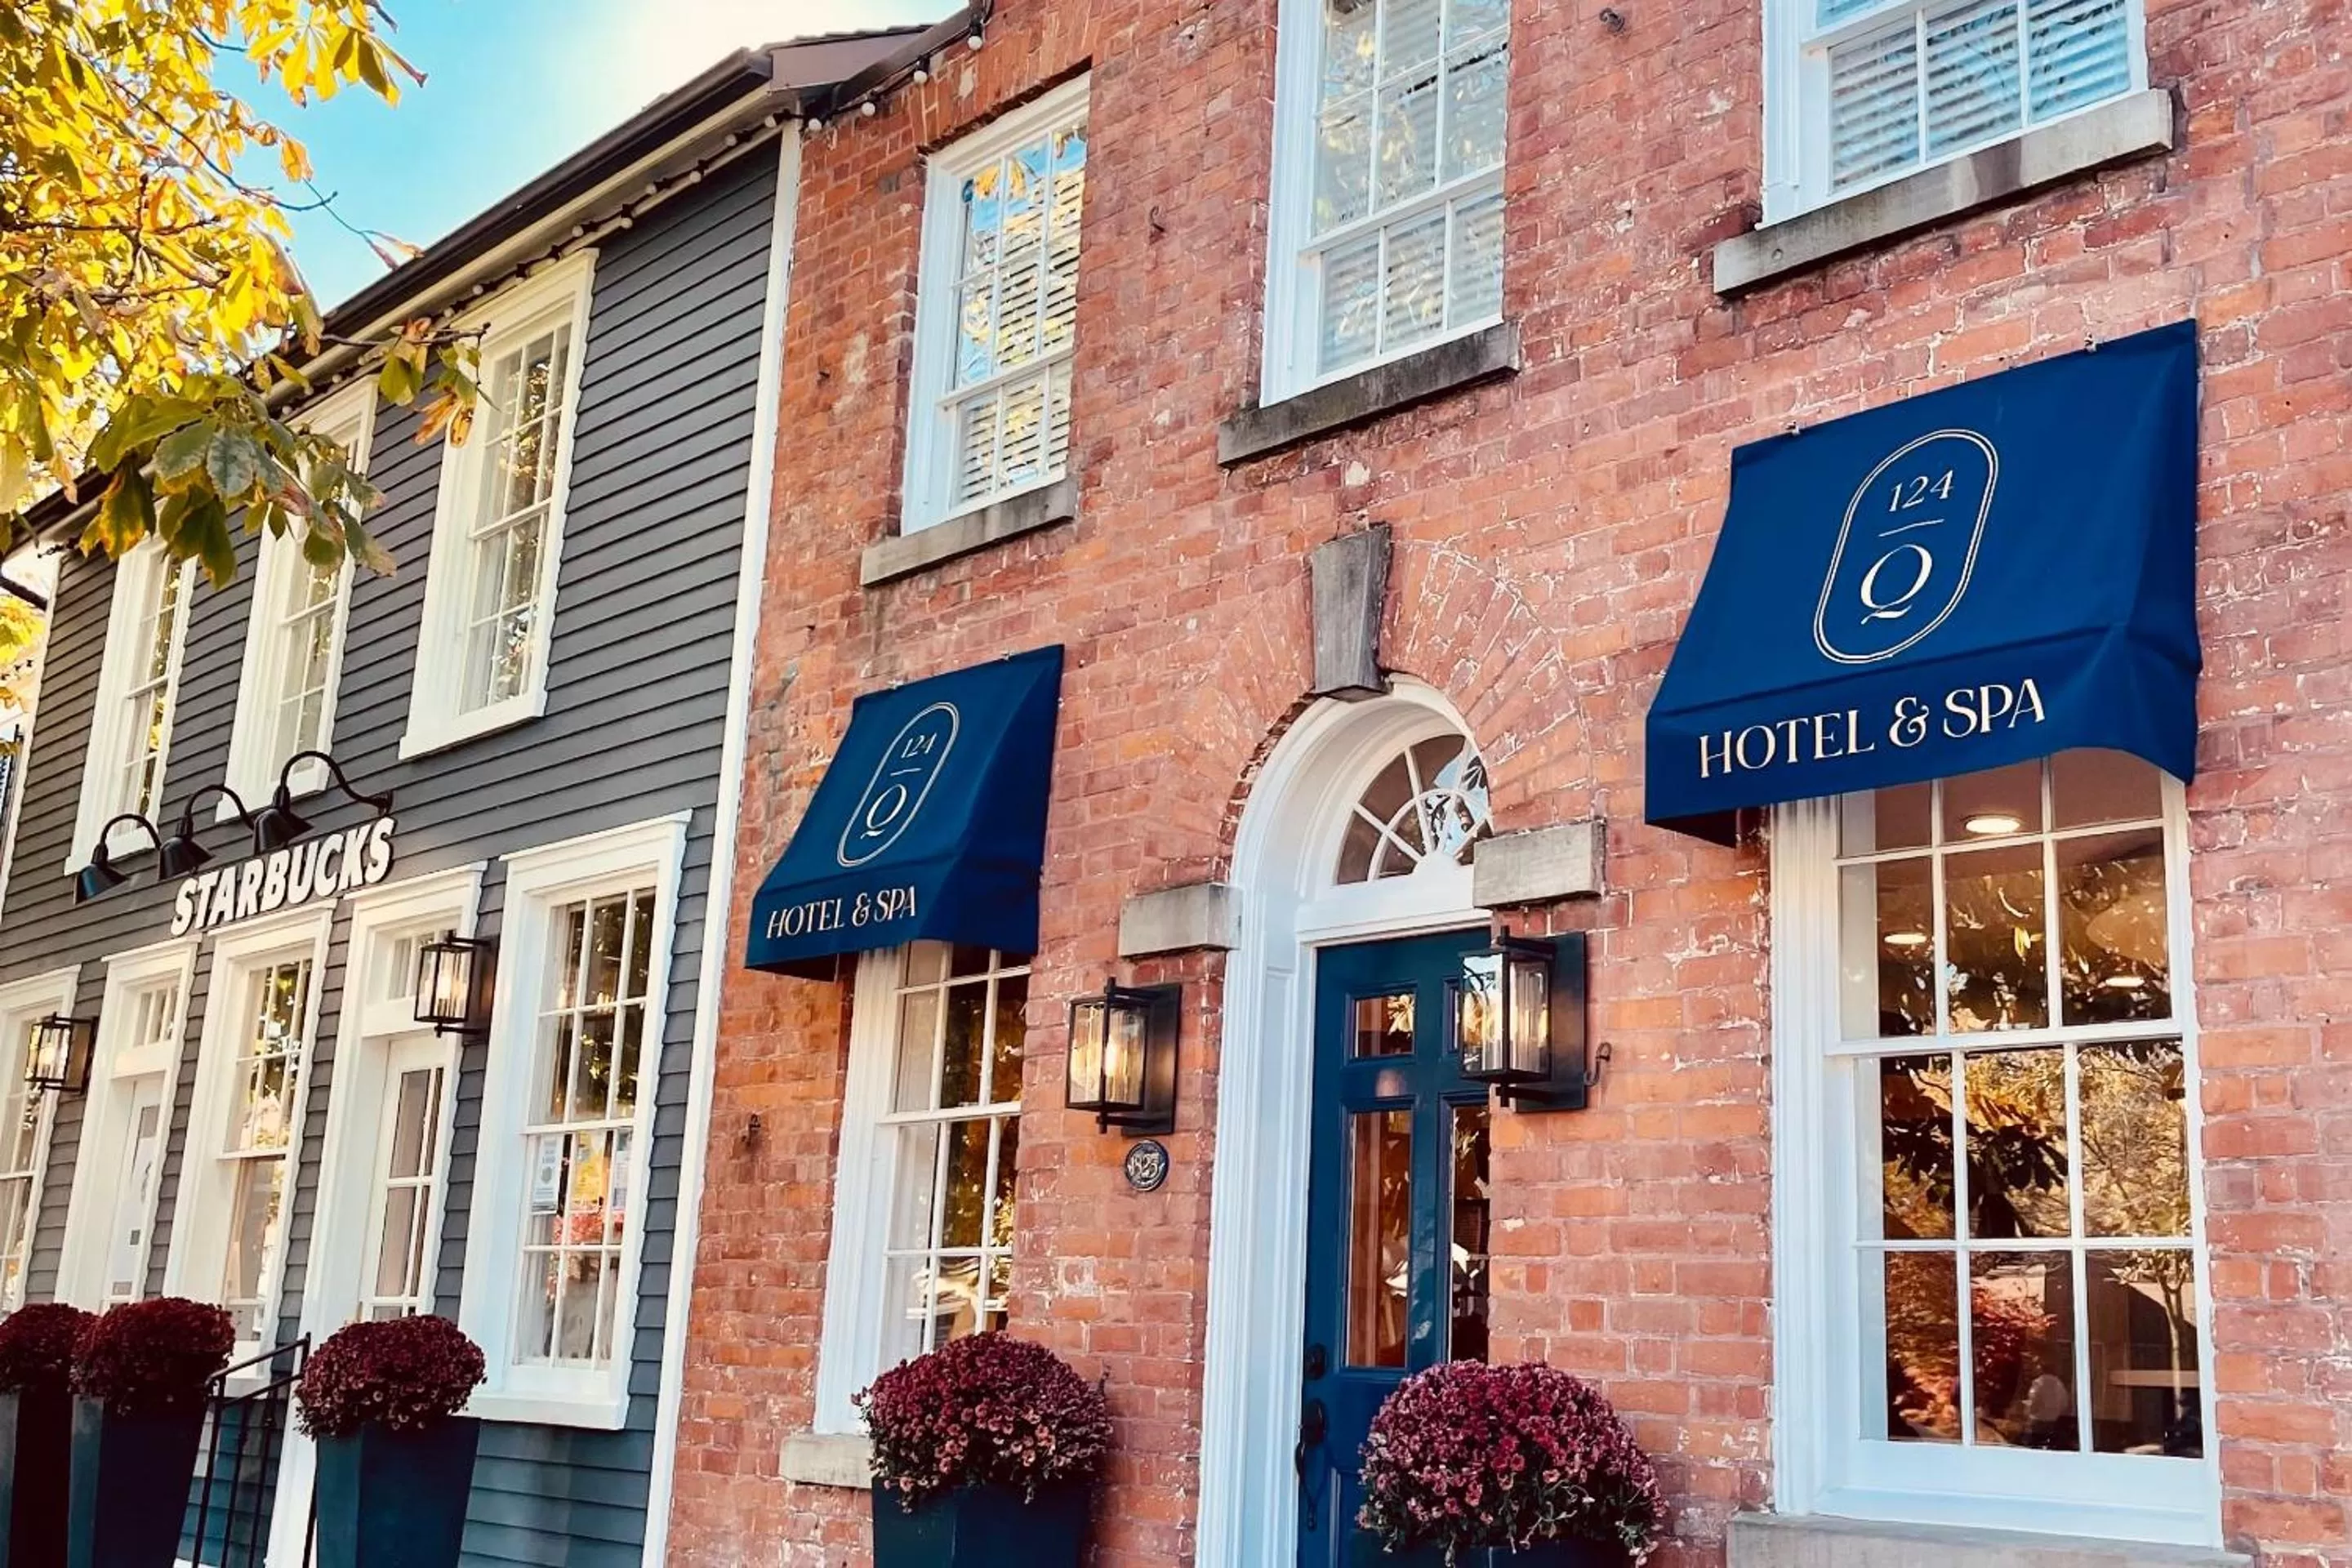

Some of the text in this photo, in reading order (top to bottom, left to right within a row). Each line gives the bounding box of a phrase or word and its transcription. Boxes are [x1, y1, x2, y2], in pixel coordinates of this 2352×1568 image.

[1887, 470, 1954, 513] 124
[1859, 543, 1933, 625] Q
[900, 733, 938, 760] 124
[1698, 678, 2046, 780] HOTEL & SPA
[860, 783, 906, 840] Q
[170, 817, 396, 936] STARBUCKS
[765, 885, 916, 939] HOTEL & SPA
[1129, 1152, 1160, 1178] 1825
